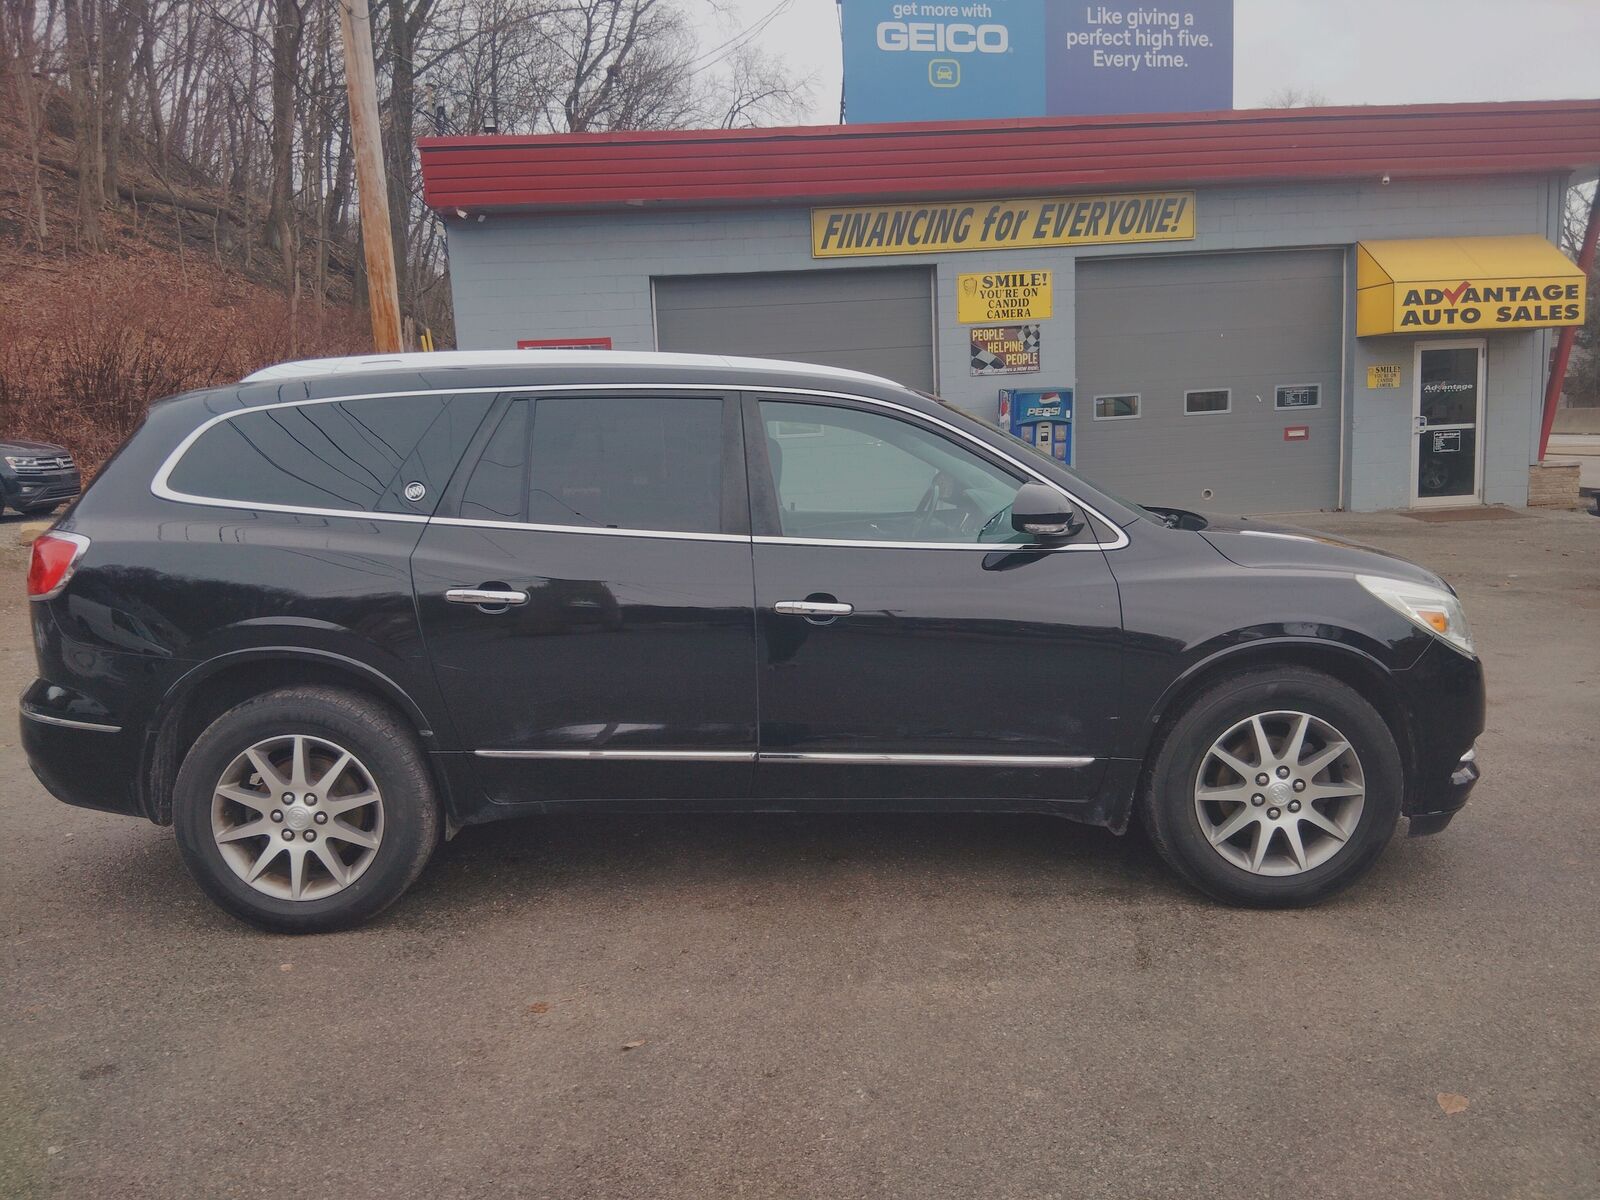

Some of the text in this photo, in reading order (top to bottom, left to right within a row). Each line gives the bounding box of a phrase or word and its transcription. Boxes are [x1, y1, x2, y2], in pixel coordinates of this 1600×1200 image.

[893, 3, 992, 18] get more with
[1087, 7, 1194, 30] Like giving a
[876, 21, 1009, 53] GEICO
[1066, 28, 1213, 50] perfect high five.
[1093, 49, 1188, 71] Every time.
[820, 198, 1184, 249] FINANCING for EVERYONE!
[982, 273, 1047, 289] SMILE!
[980, 287, 1038, 299] YOU'RE ON
[988, 298, 1029, 309] CANDID
[986, 308, 1031, 319] CAMERA
[1400, 304, 1579, 327] AUTO SALES
[972, 328, 1005, 342] PEOPLE
[987, 340, 1024, 353] HELPING
[1005, 352, 1038, 366] PEOPLE
